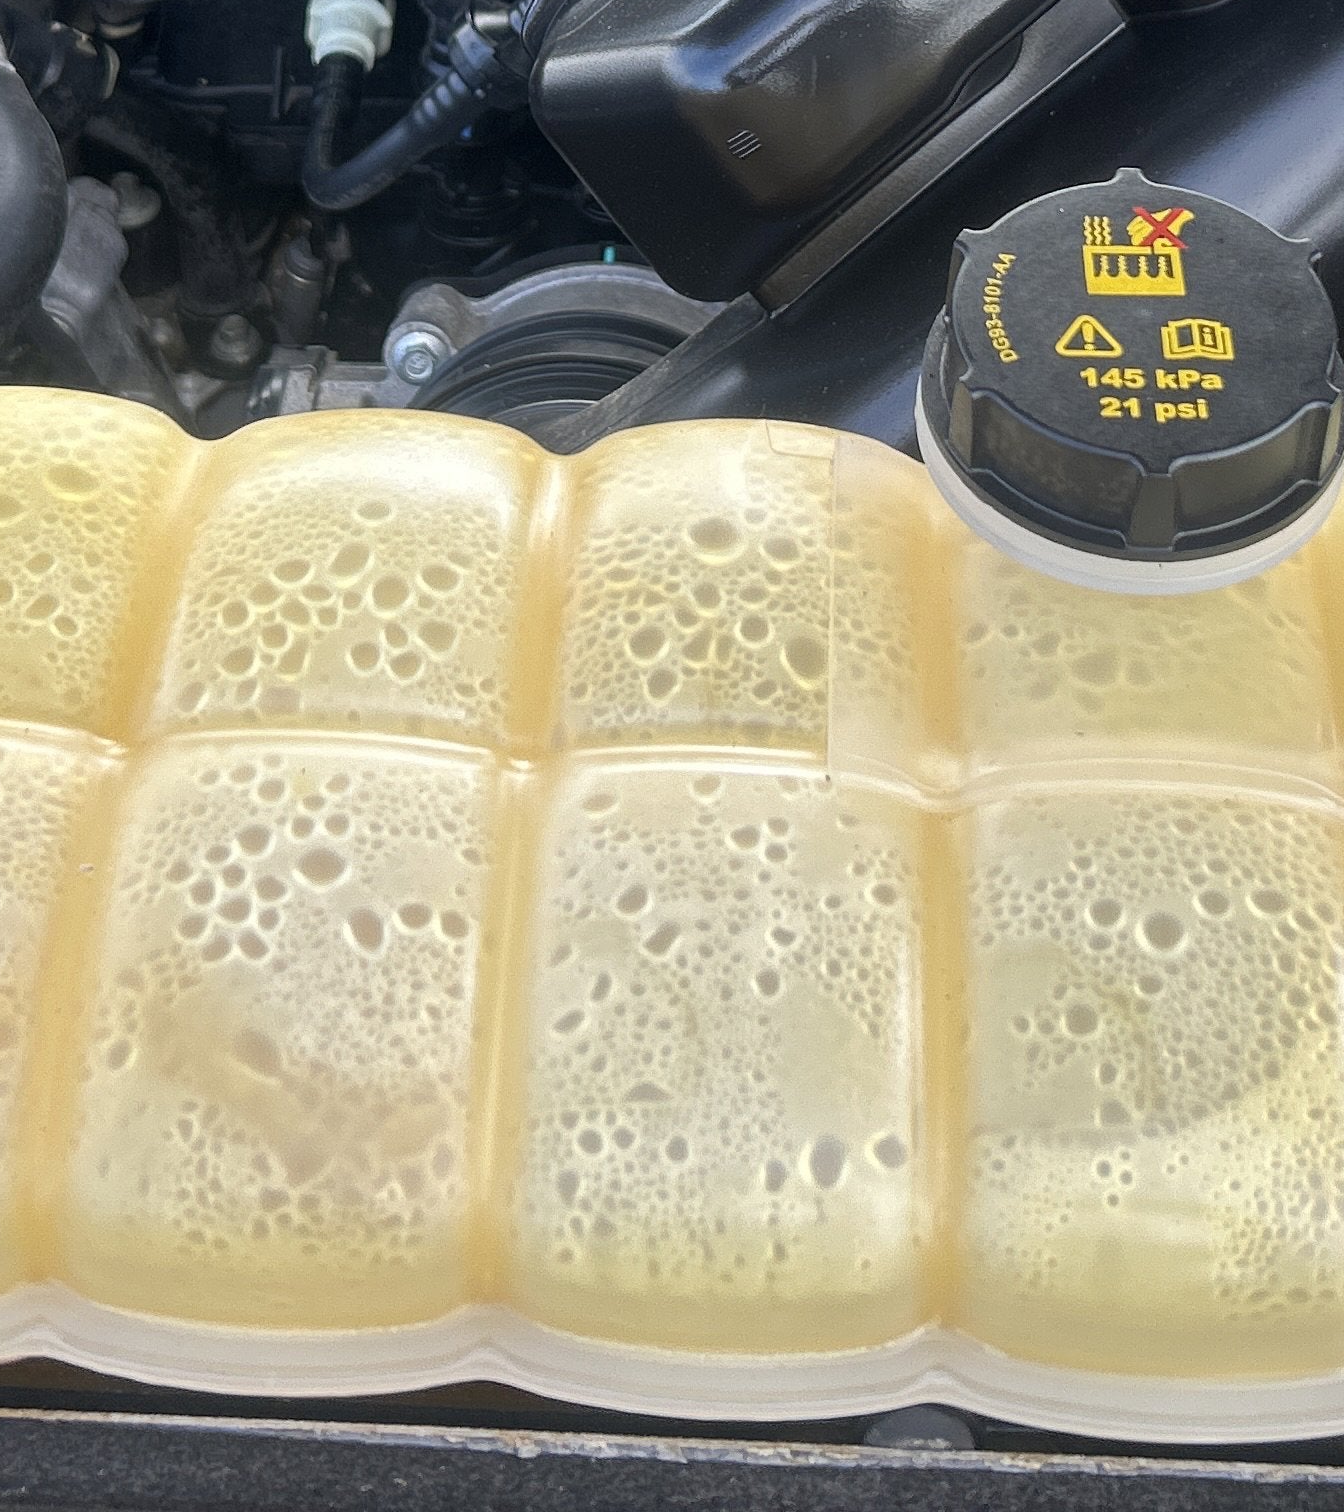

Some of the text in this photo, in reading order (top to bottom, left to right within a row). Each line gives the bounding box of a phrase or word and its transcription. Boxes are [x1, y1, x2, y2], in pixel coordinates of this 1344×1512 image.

[983, 253, 1019, 363] DG93-8101-AA
[1081, 367, 1224, 390] 145 kPa
[1100, 396, 1209, 423] 21 psi
